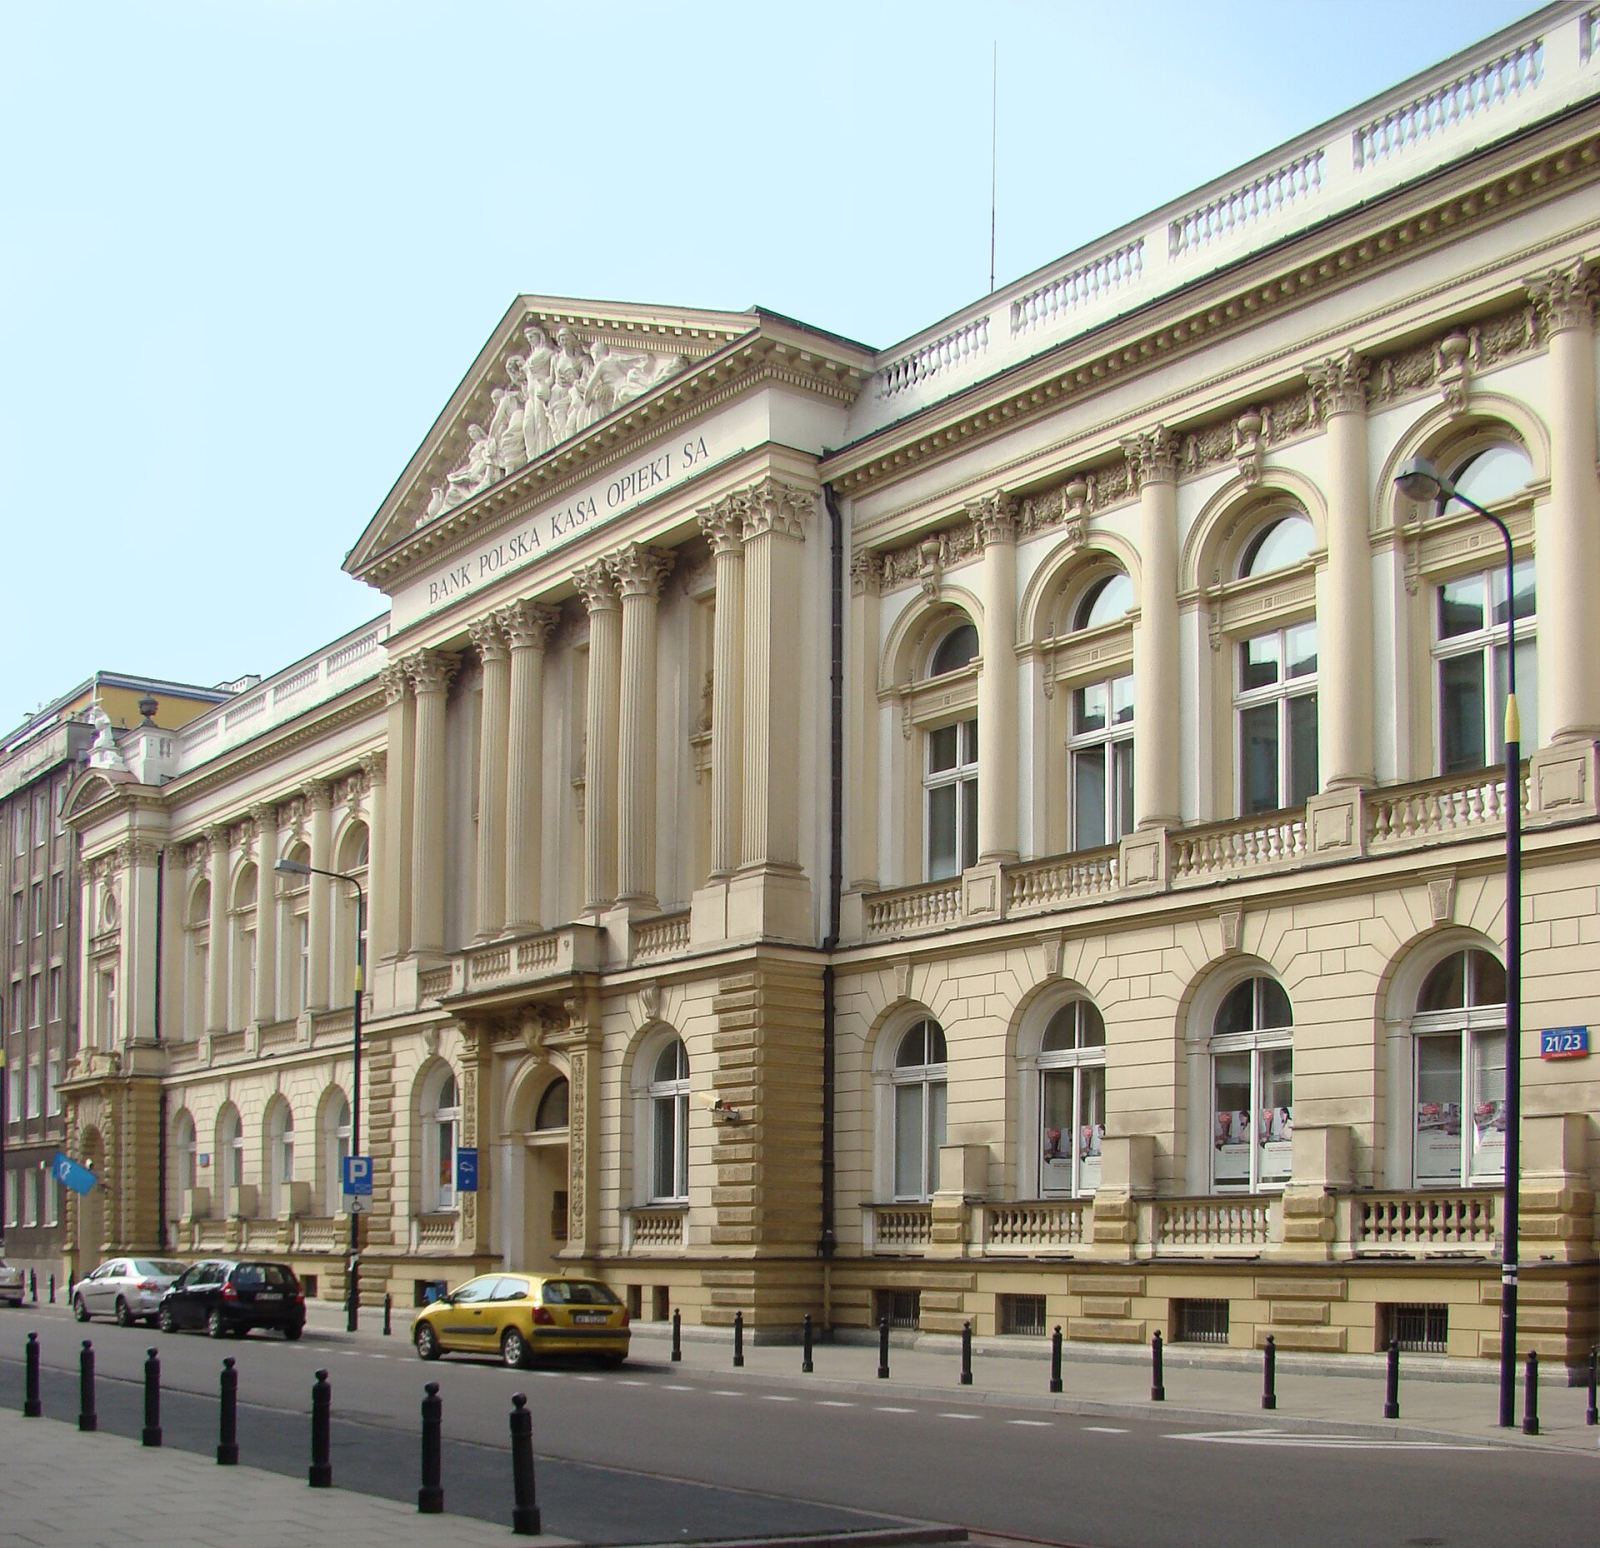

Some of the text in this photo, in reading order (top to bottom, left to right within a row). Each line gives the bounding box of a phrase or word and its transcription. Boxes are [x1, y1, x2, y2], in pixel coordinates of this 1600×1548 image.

[429, 436, 710, 604] BANK POLSKA KASA OPIEKI SA
[1545, 1035, 1580, 1052] 21/23
[350, 1160, 367, 1183] P
